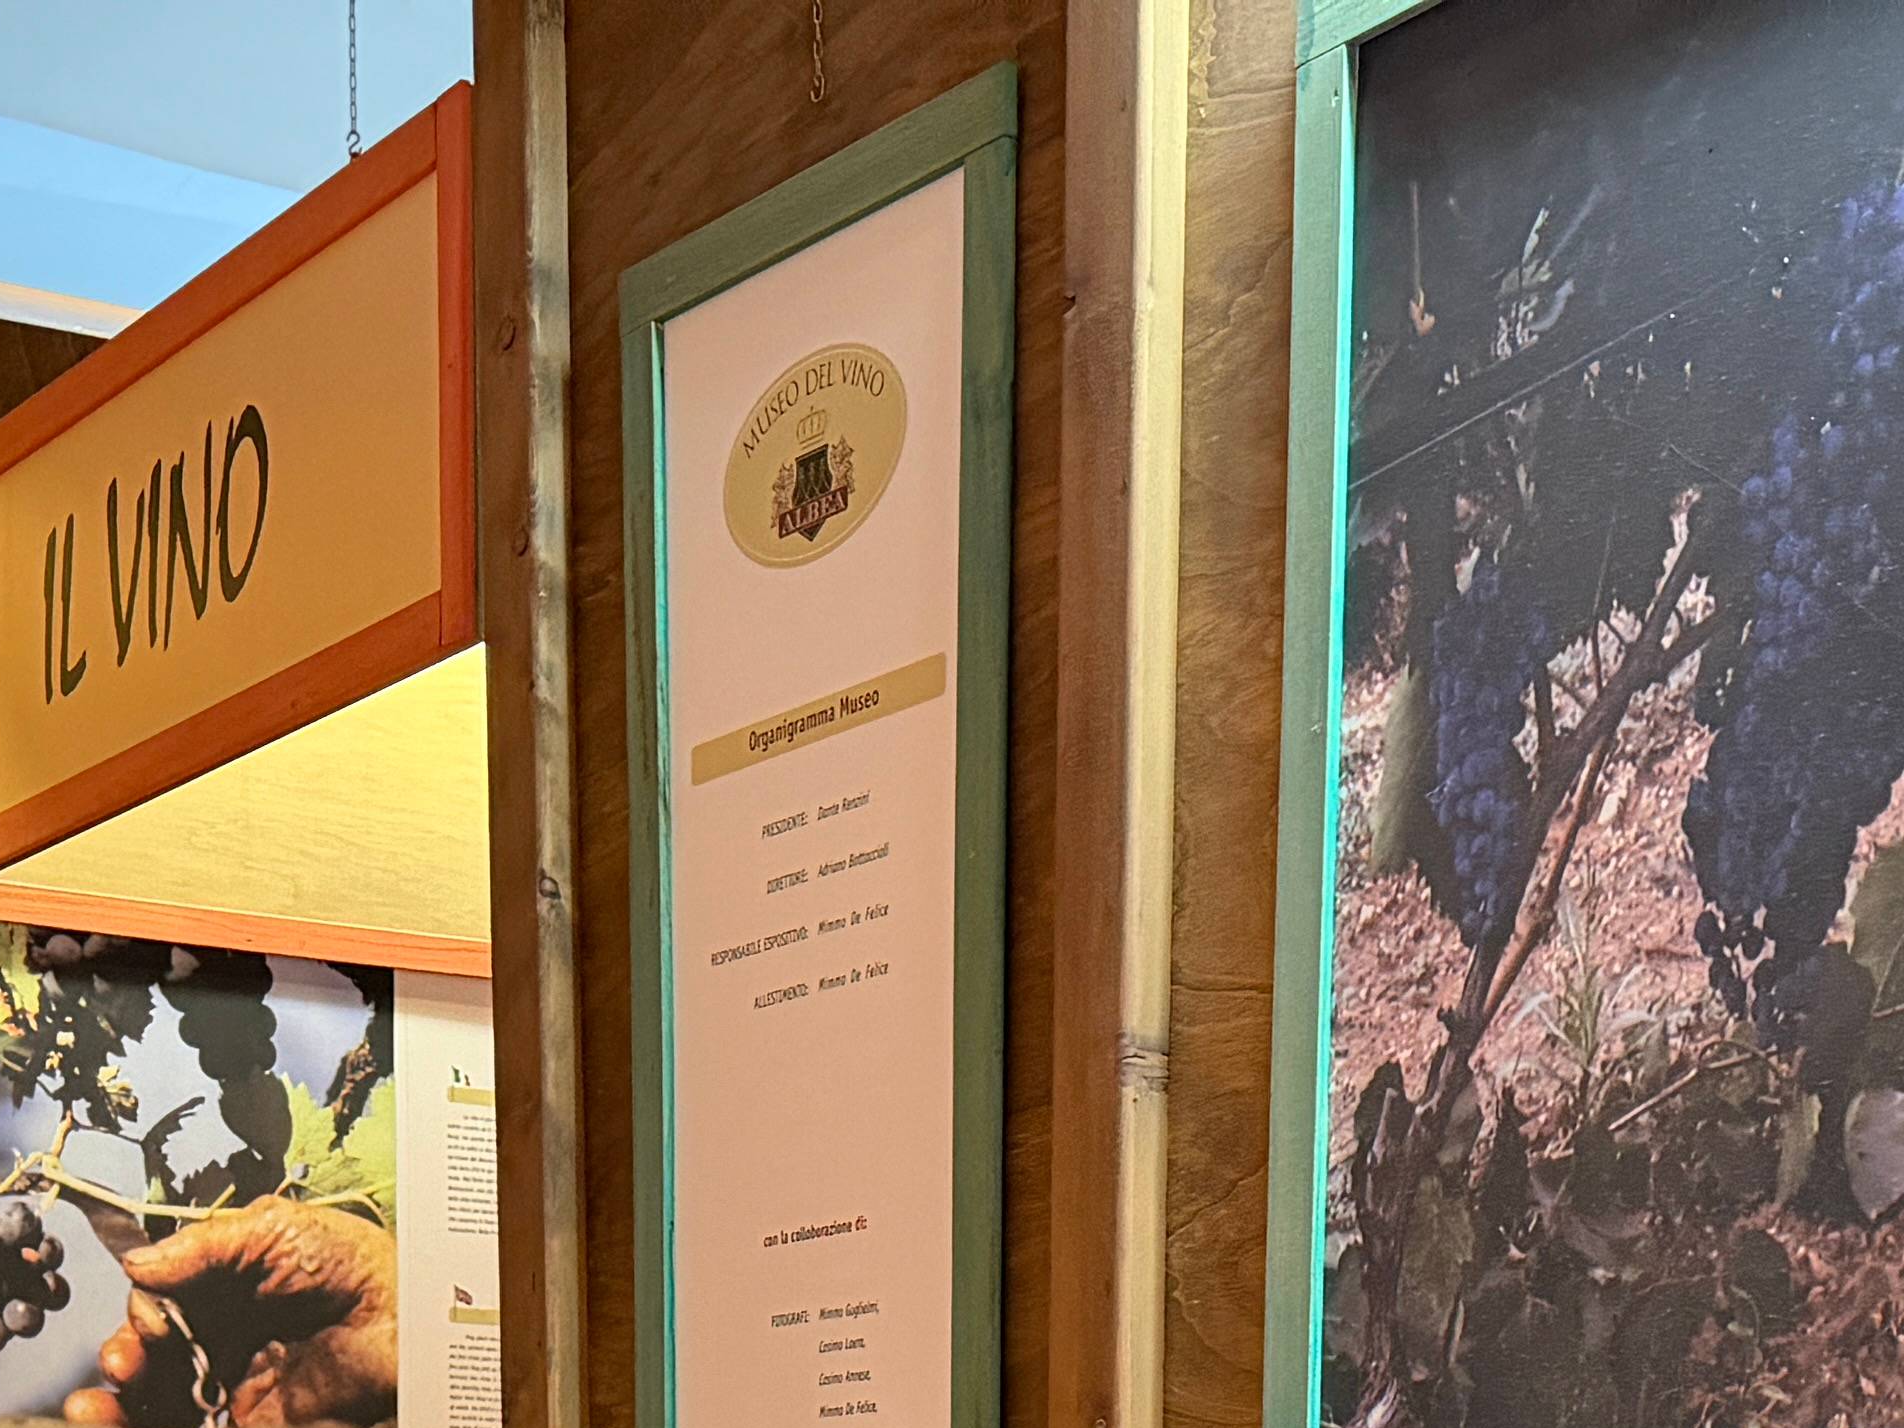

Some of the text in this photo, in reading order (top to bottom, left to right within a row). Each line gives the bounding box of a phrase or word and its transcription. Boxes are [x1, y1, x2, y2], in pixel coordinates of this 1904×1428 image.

[743, 359, 885, 459] MUSEO DEL VINO
[782, 490, 845, 533] ALBEA
[44, 404, 268, 705] IL VINO
[748, 687, 880, 753] Organigramma Museo
[761, 811, 809, 840] PRESIDENTE:
[817, 917, 846, 936] Mimmo
[850, 911, 861, 925] De
[865, 903, 889, 922] Felice
[850, 968, 862, 984] De
[864, 961, 889, 980] Felice
[763, 1231, 778, 1248] con
[781, 1230, 788, 1245] la
[791, 1220, 852, 1243] collaborazione
